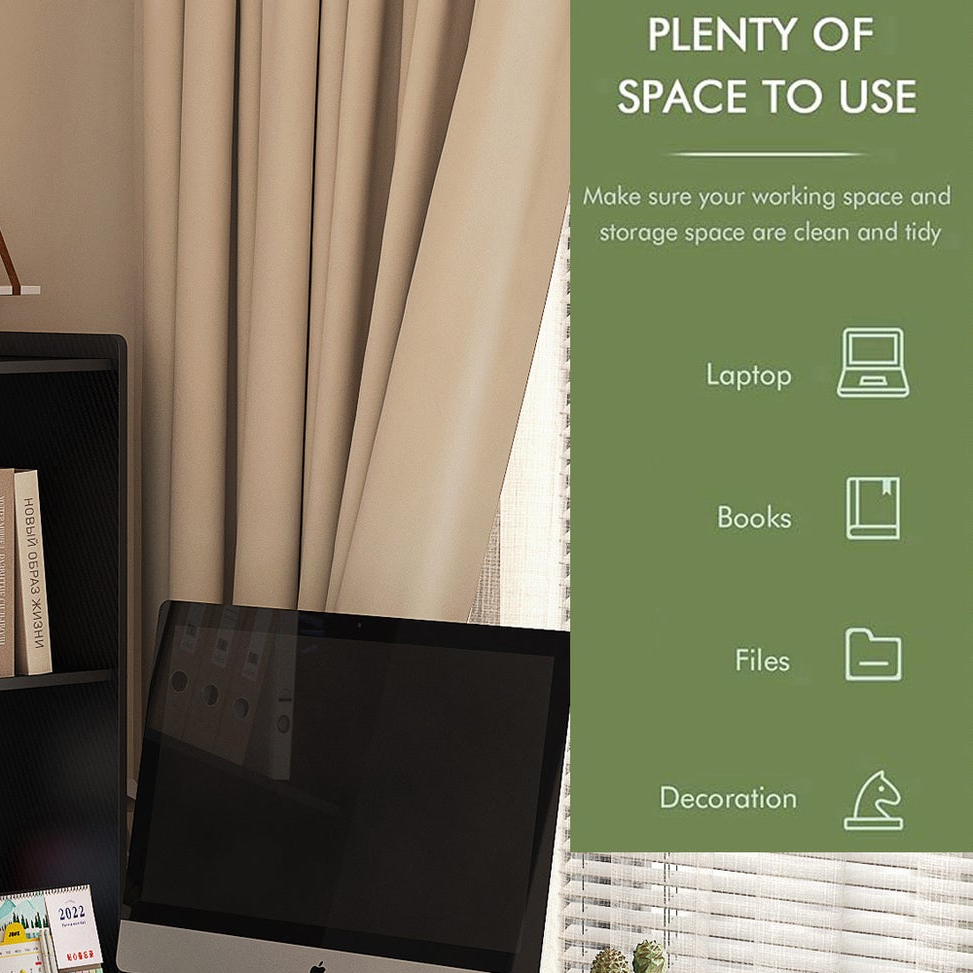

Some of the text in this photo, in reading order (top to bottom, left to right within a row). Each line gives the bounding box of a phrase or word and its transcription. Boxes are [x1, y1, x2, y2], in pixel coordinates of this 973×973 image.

[23, 497, 45, 649] НОВЫЙ ОБРАЗ ЖИЗНИ
[58, 904, 86, 921] 2022
